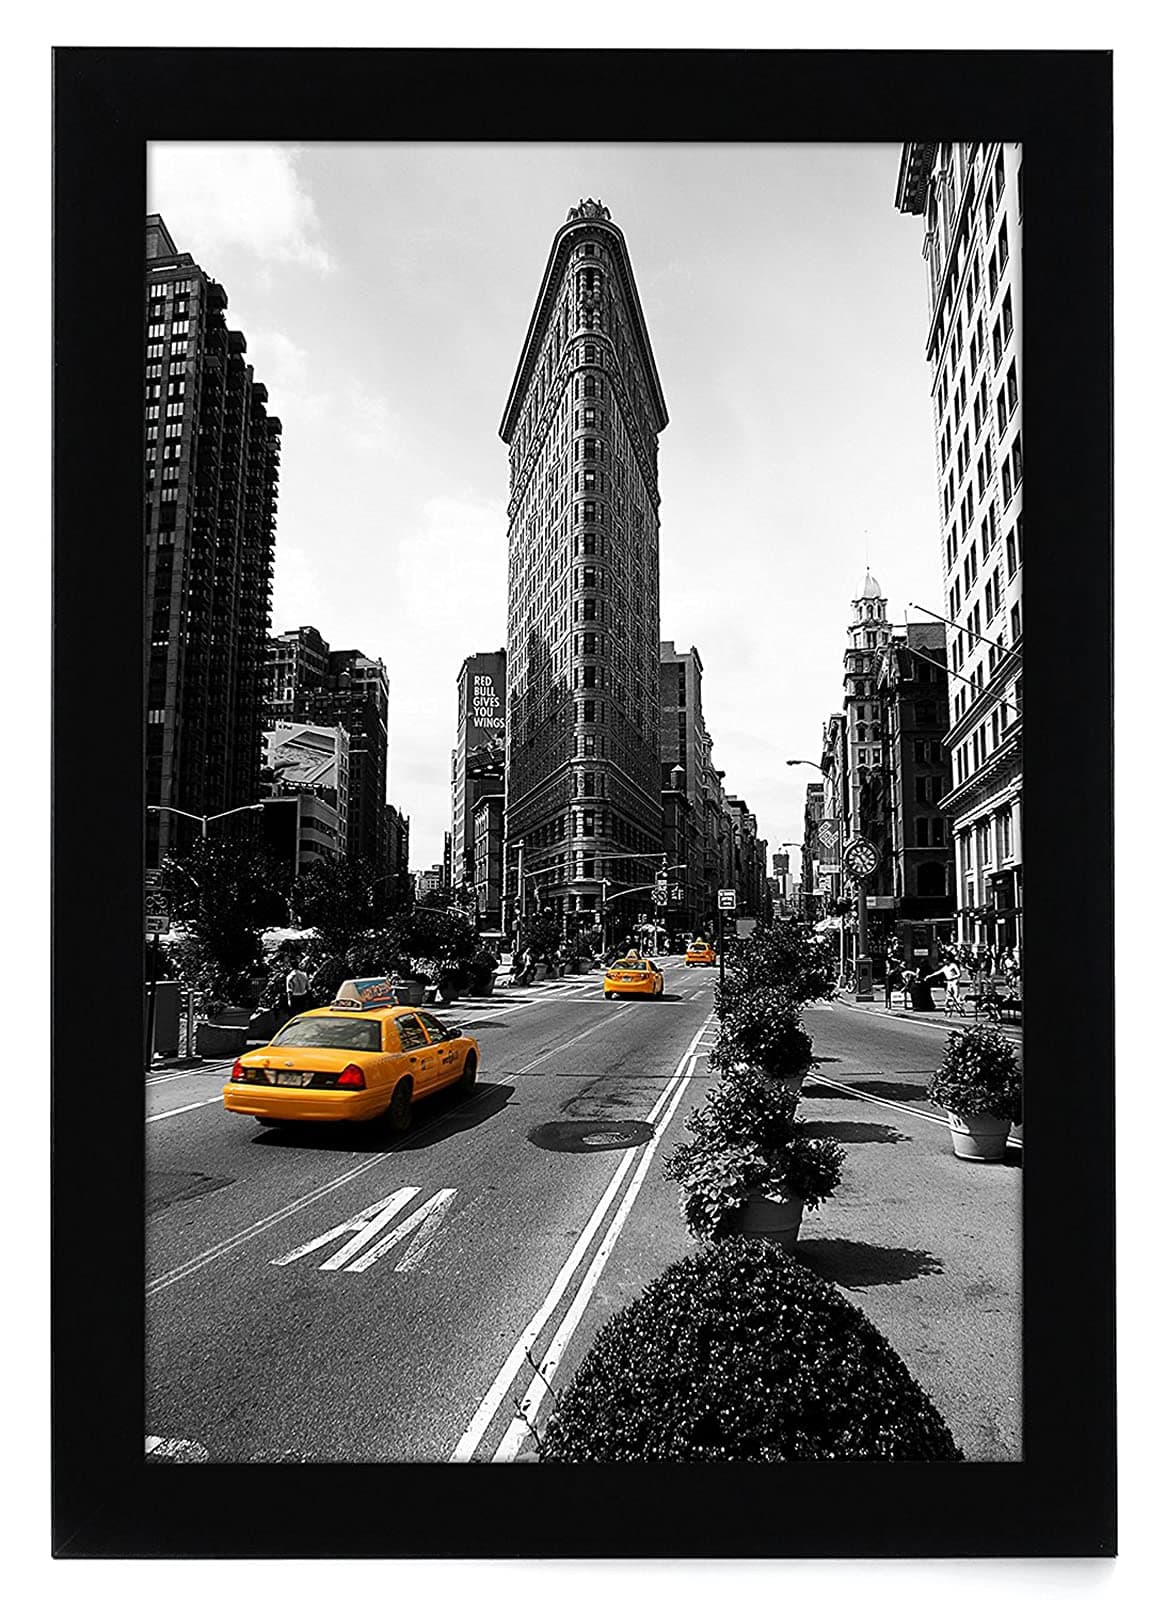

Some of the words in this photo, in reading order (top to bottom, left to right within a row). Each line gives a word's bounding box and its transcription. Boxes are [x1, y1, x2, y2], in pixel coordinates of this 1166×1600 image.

[474, 675, 492, 686] RED
[474, 686, 496, 697] BULL
[473, 696, 500, 707] GIVES
[473, 706, 494, 717] YOU
[473, 717, 505, 728] WINGS
